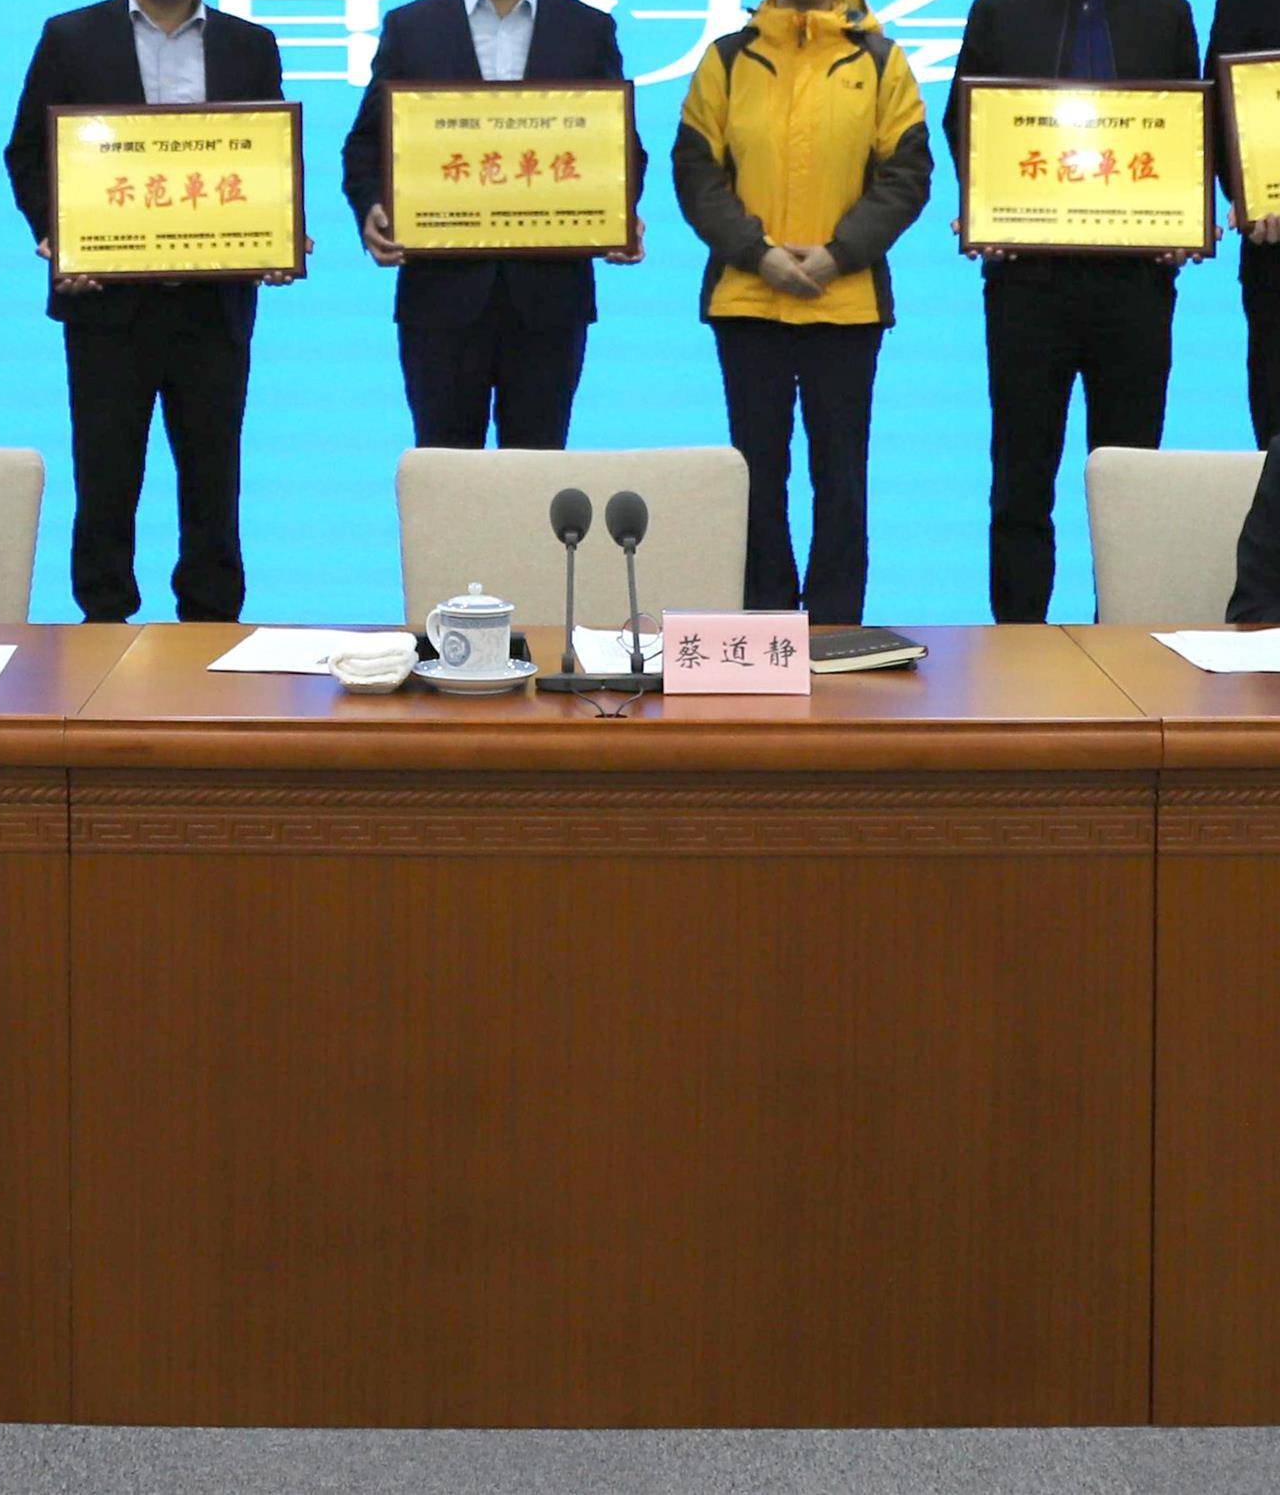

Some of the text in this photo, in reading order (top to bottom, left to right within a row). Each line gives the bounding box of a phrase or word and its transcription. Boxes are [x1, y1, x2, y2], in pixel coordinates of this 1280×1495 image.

[441, 148, 581, 187] 示范单位
[106, 171, 247, 211] 示范单位
[675, 633, 797, 669] 蔡道静
